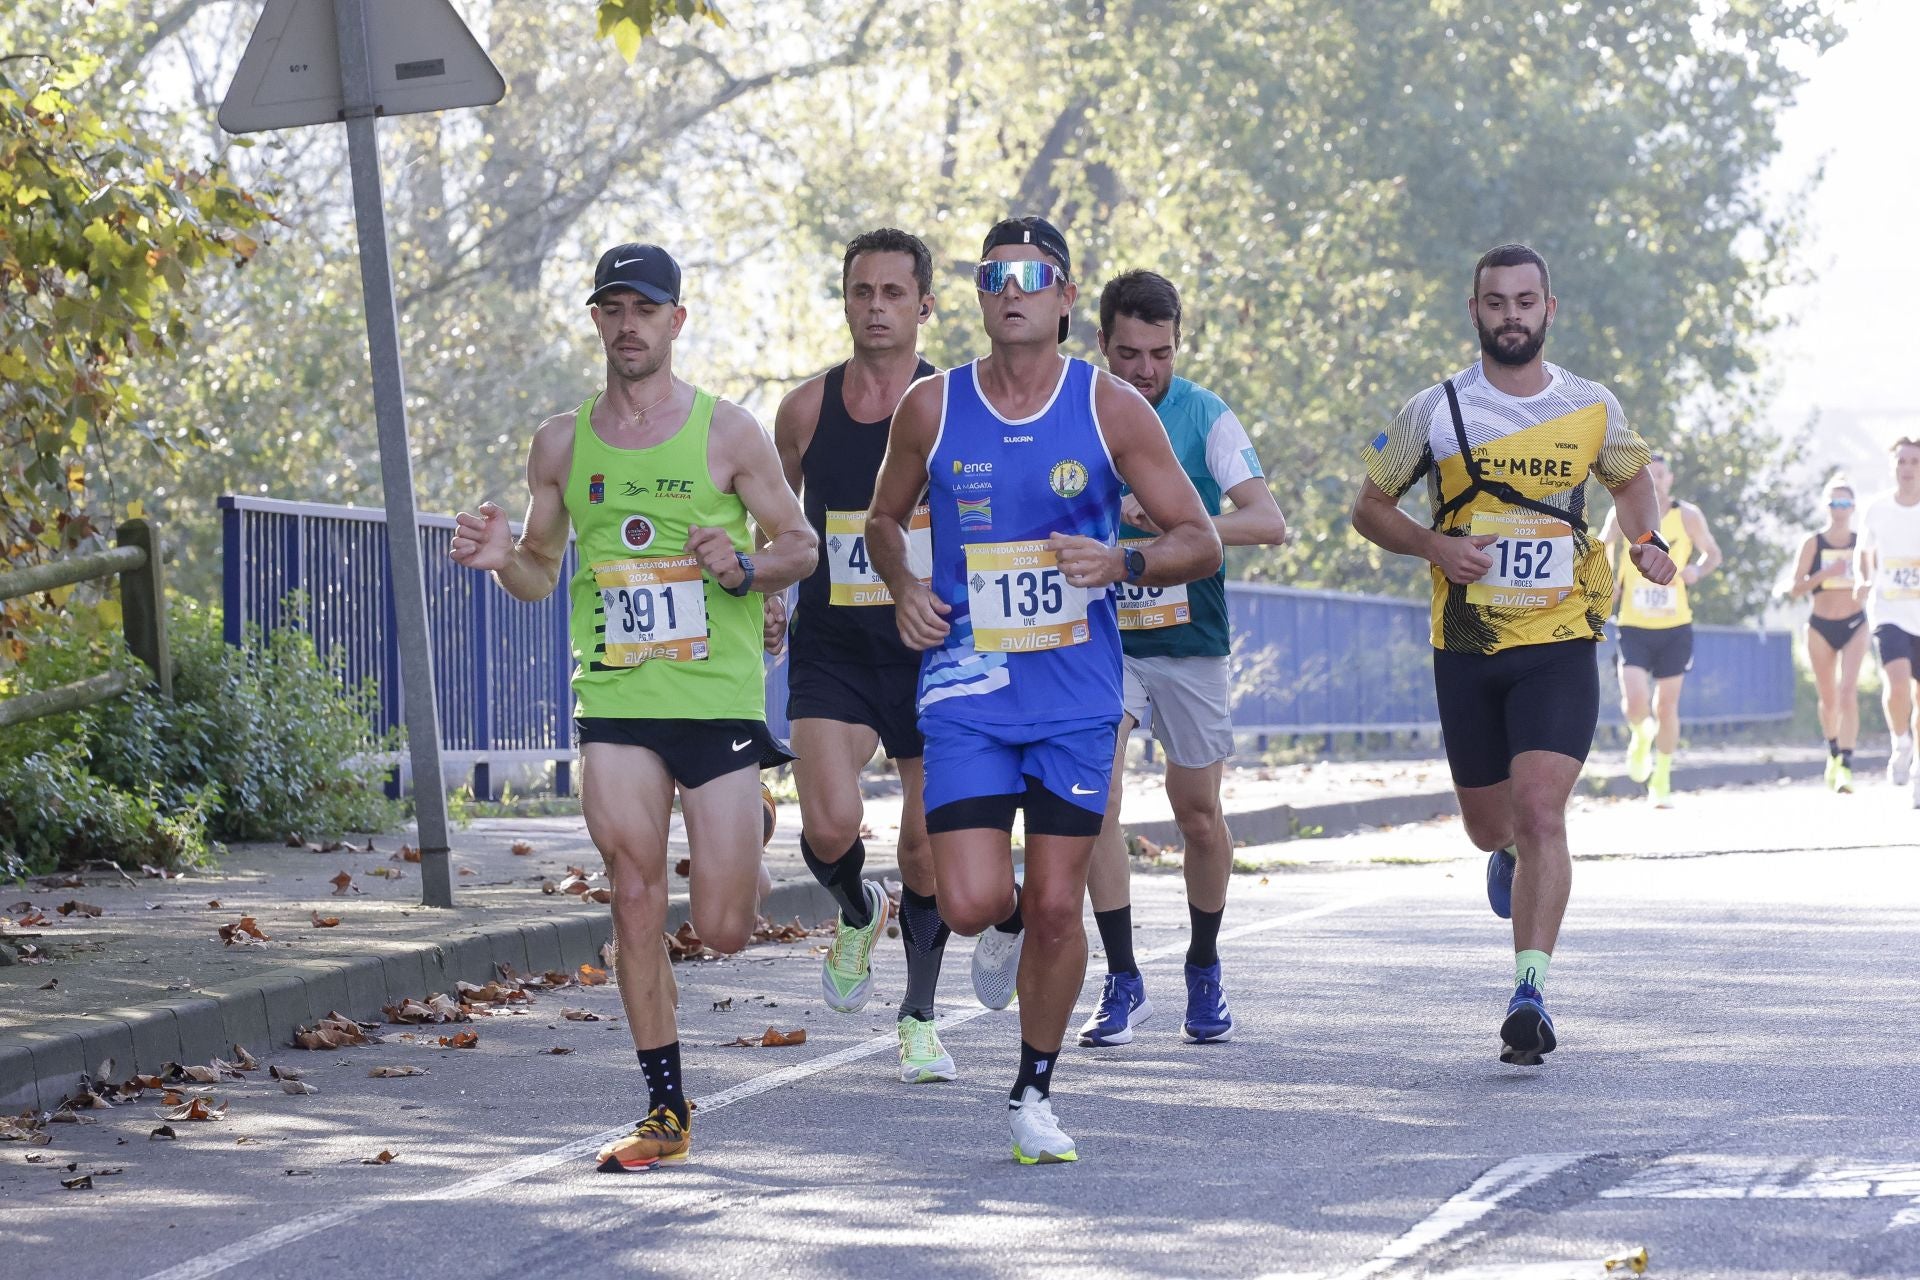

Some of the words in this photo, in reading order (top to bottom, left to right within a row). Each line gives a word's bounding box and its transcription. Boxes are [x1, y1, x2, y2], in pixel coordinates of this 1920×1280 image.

[1478, 457, 1572, 477] CUMBRE
[656, 479, 694, 493] TFC
[953, 483, 961, 491] LA
[962, 482, 993, 490] MAGAYA
[1495, 516, 1517, 524] MEDIA
[1519, 517, 1551, 525] MARATÓN
[1514, 527, 1536, 535] 2024
[991, 546, 1015, 554] MEDIA
[1016, 545, 1046, 553] MARAT
[632, 561, 670, 570] MARATÓN
[671, 556, 698, 567] AVILÉS
[1012, 556, 1039, 566] 2024
[1496, 540, 1553, 579] 152
[628, 573, 654, 583] 2024
[995, 569, 1063, 618] 135
[619, 586, 677, 633] 391
[1023, 617, 1037, 626] UVE
